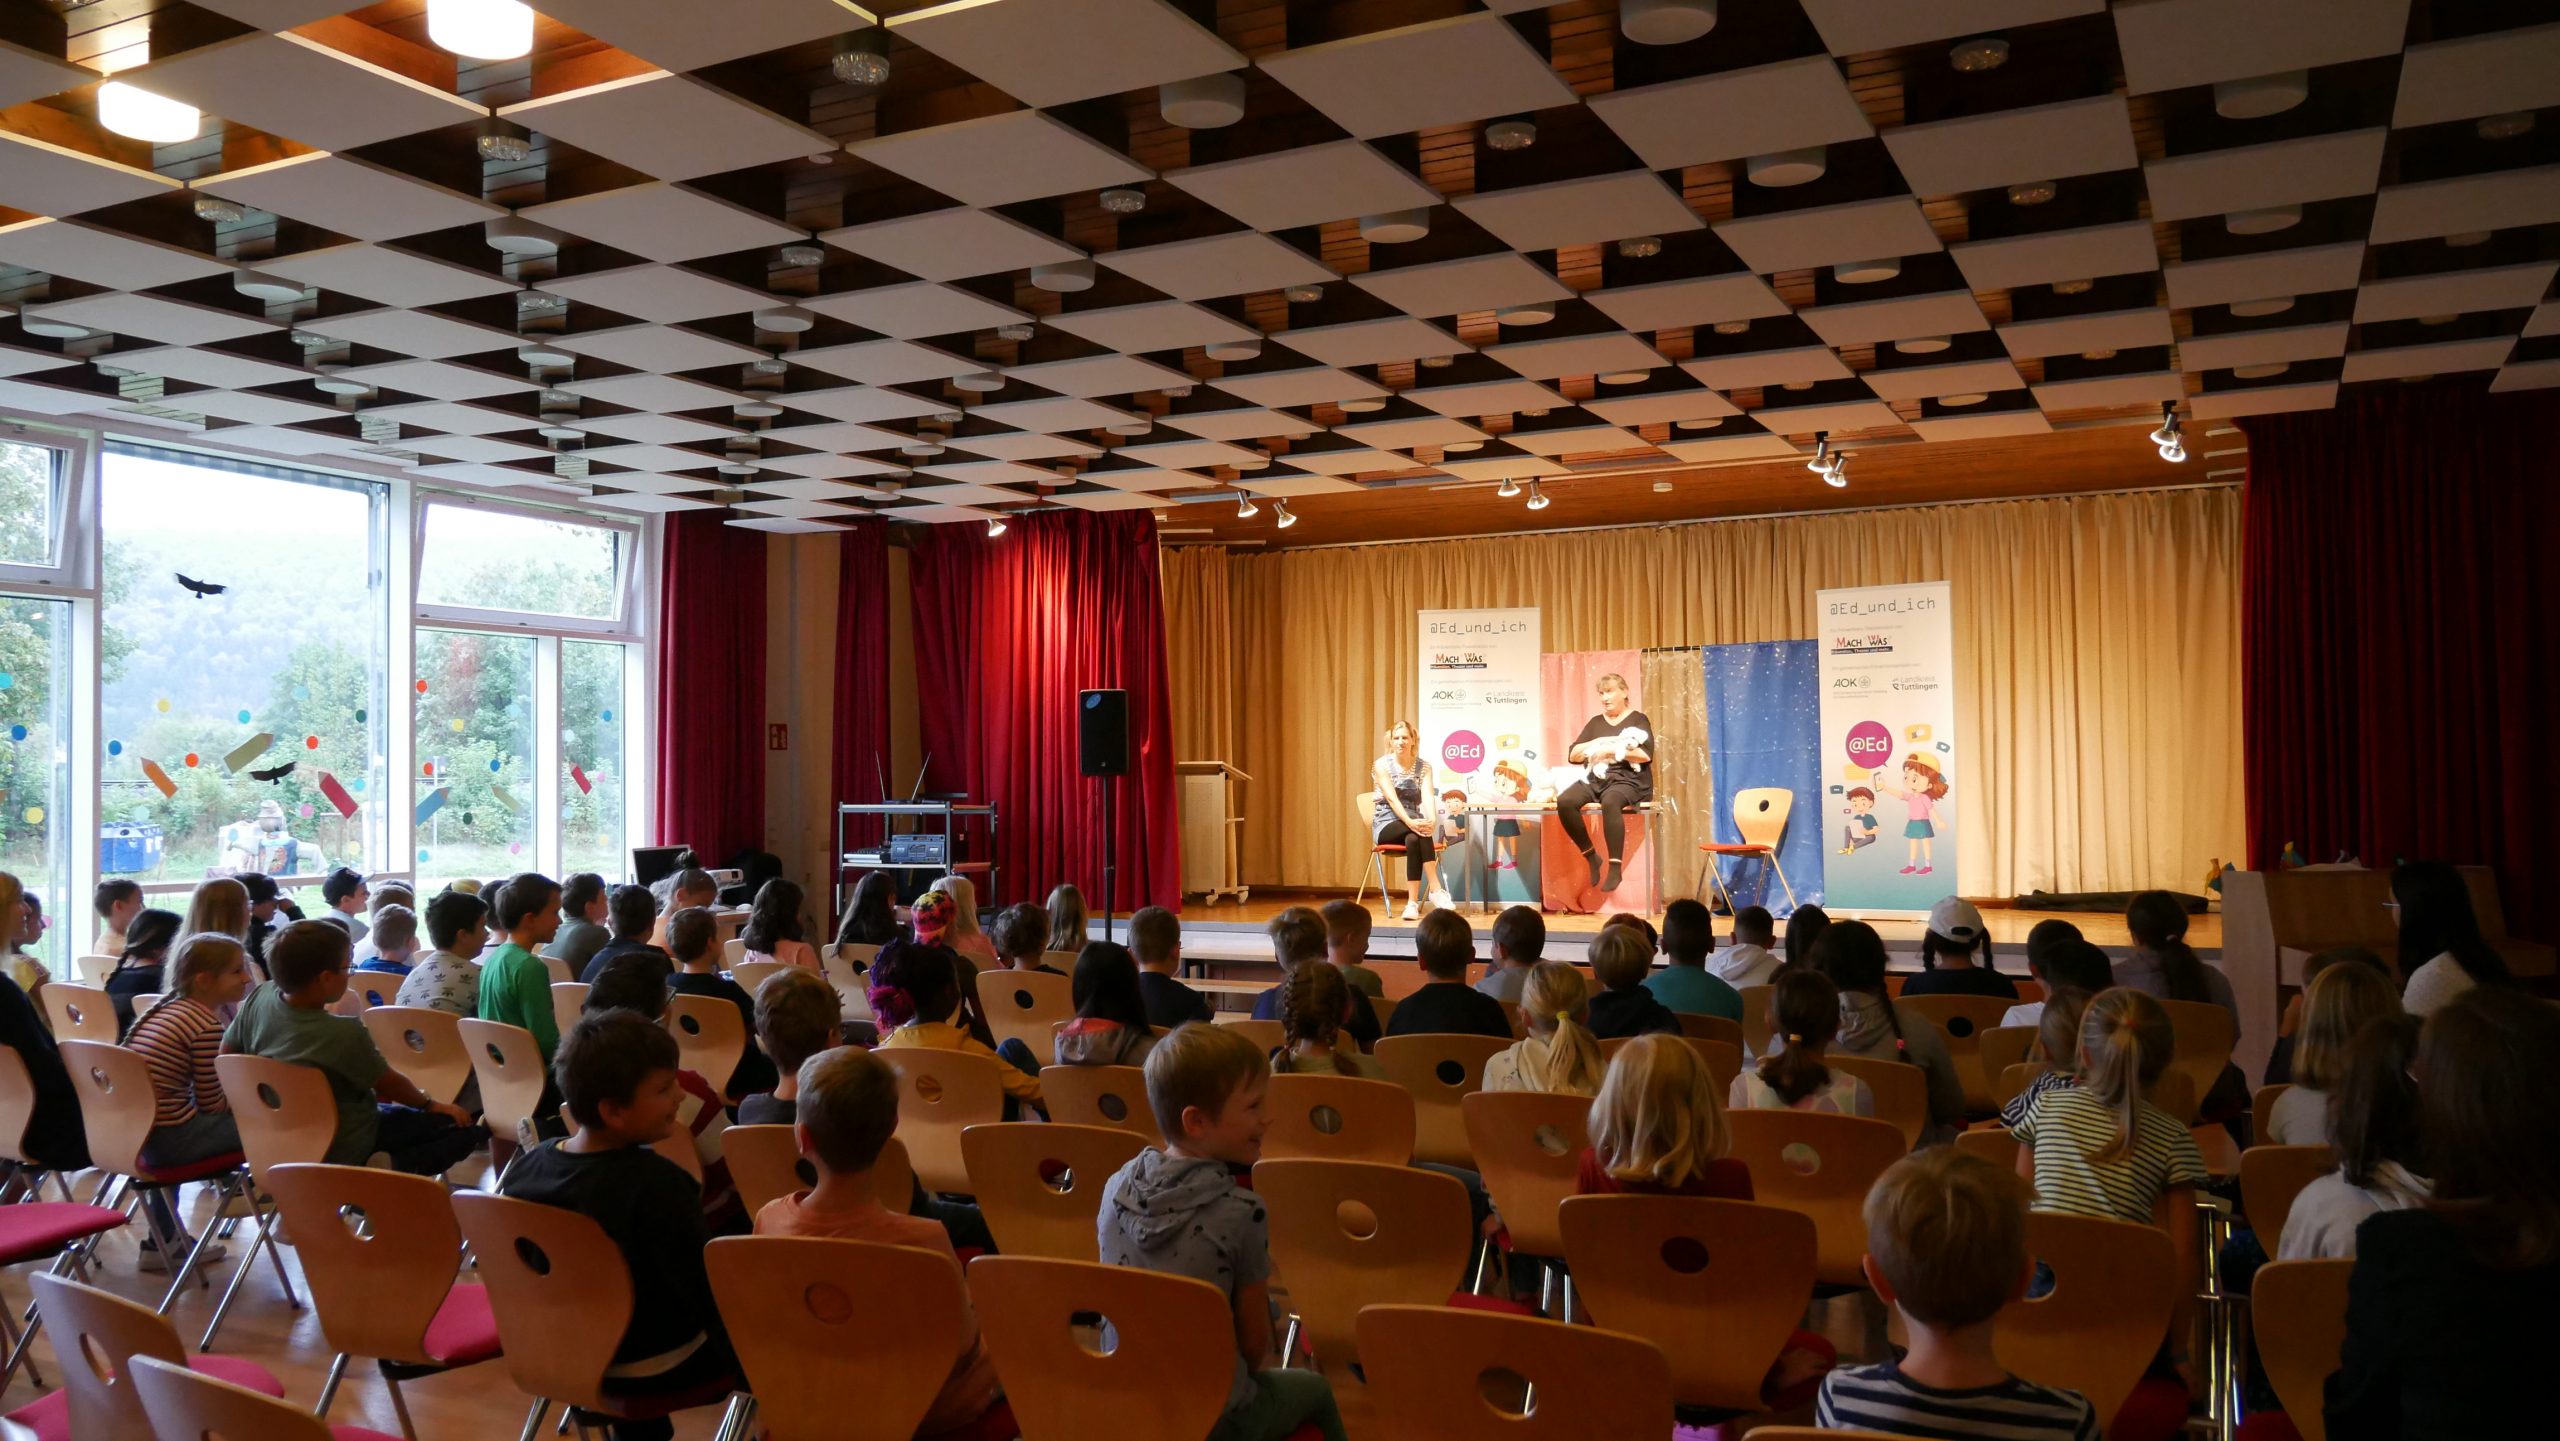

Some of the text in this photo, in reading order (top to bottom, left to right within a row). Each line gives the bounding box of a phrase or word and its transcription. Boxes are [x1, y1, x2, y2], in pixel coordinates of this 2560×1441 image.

[1830, 597, 1936, 616] @Ed_und_ich
[1430, 621, 1527, 635] @Ed_und_ich
[1833, 678, 1858, 688] AOK
[1900, 683, 1938, 692] Tuttlingen
[1432, 690, 1454, 700] AOK
[1493, 697, 1528, 705] Tuttlingen
[1849, 736, 1888, 753] @Ed
[1444, 744, 1480, 759] @Ed
